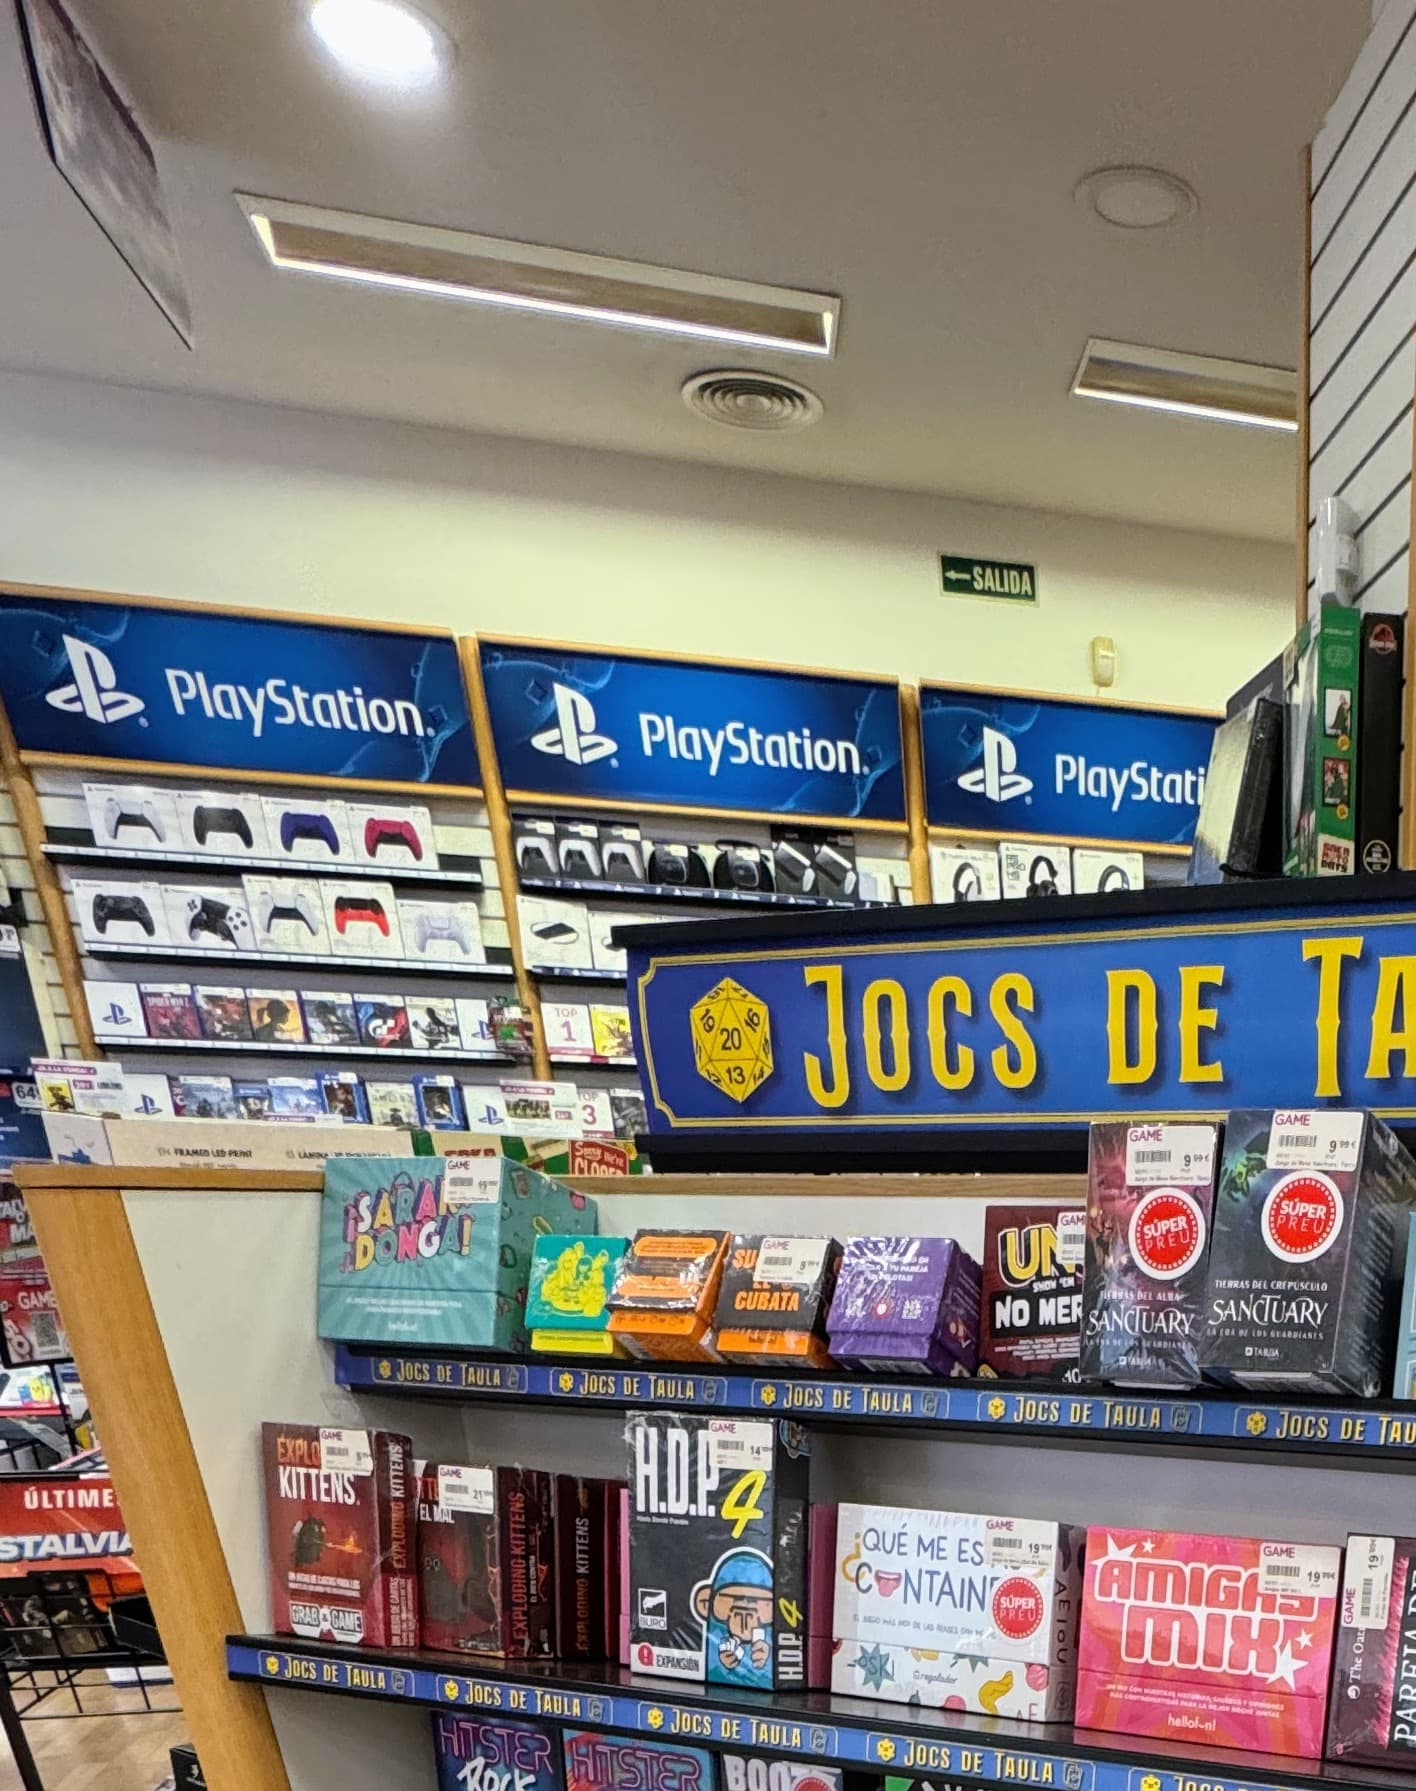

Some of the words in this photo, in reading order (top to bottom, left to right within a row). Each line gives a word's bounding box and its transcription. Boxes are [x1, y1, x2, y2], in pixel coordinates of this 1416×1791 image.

[972, 566, 1033, 597] SALIDA
[164, 668, 426, 738] PlayStation
[638, 712, 861, 777] PlayStation
[1055, 753, 1205, 812] PlayStati
[720, 1028, 742, 1051] 20
[803, 964, 1040, 1108] JOCS
[1106, 965, 1225, 1085] DE
[727, 1067, 746, 1085] 13
[1330, 1140, 1337, 1153] 9
[1277, 1214, 1326, 1234] PREU
[1280, 1199, 1327, 1220] SÚPER
[1144, 1216, 1188, 1238] SÚPER
[1144, 1230, 1190, 1252] PREU
[1086, 1304, 1195, 1336] SANCTUARY
[1208, 1293, 1328, 1328] SANCTUARY
[397, 1358, 431, 1383] JOCS
[437, 1365, 453, 1382] DE
[460, 1362, 501, 1387] TAULA
[720, 1469, 767, 1540] 4
[1123, 1605, 1286, 1675] MIX
[438, 1720, 553, 1774] HITSTER
[904, 1739, 955, 1771] JOCS
[962, 1751, 984, 1772] DE
[994, 1751, 1053, 1783] TAULA
